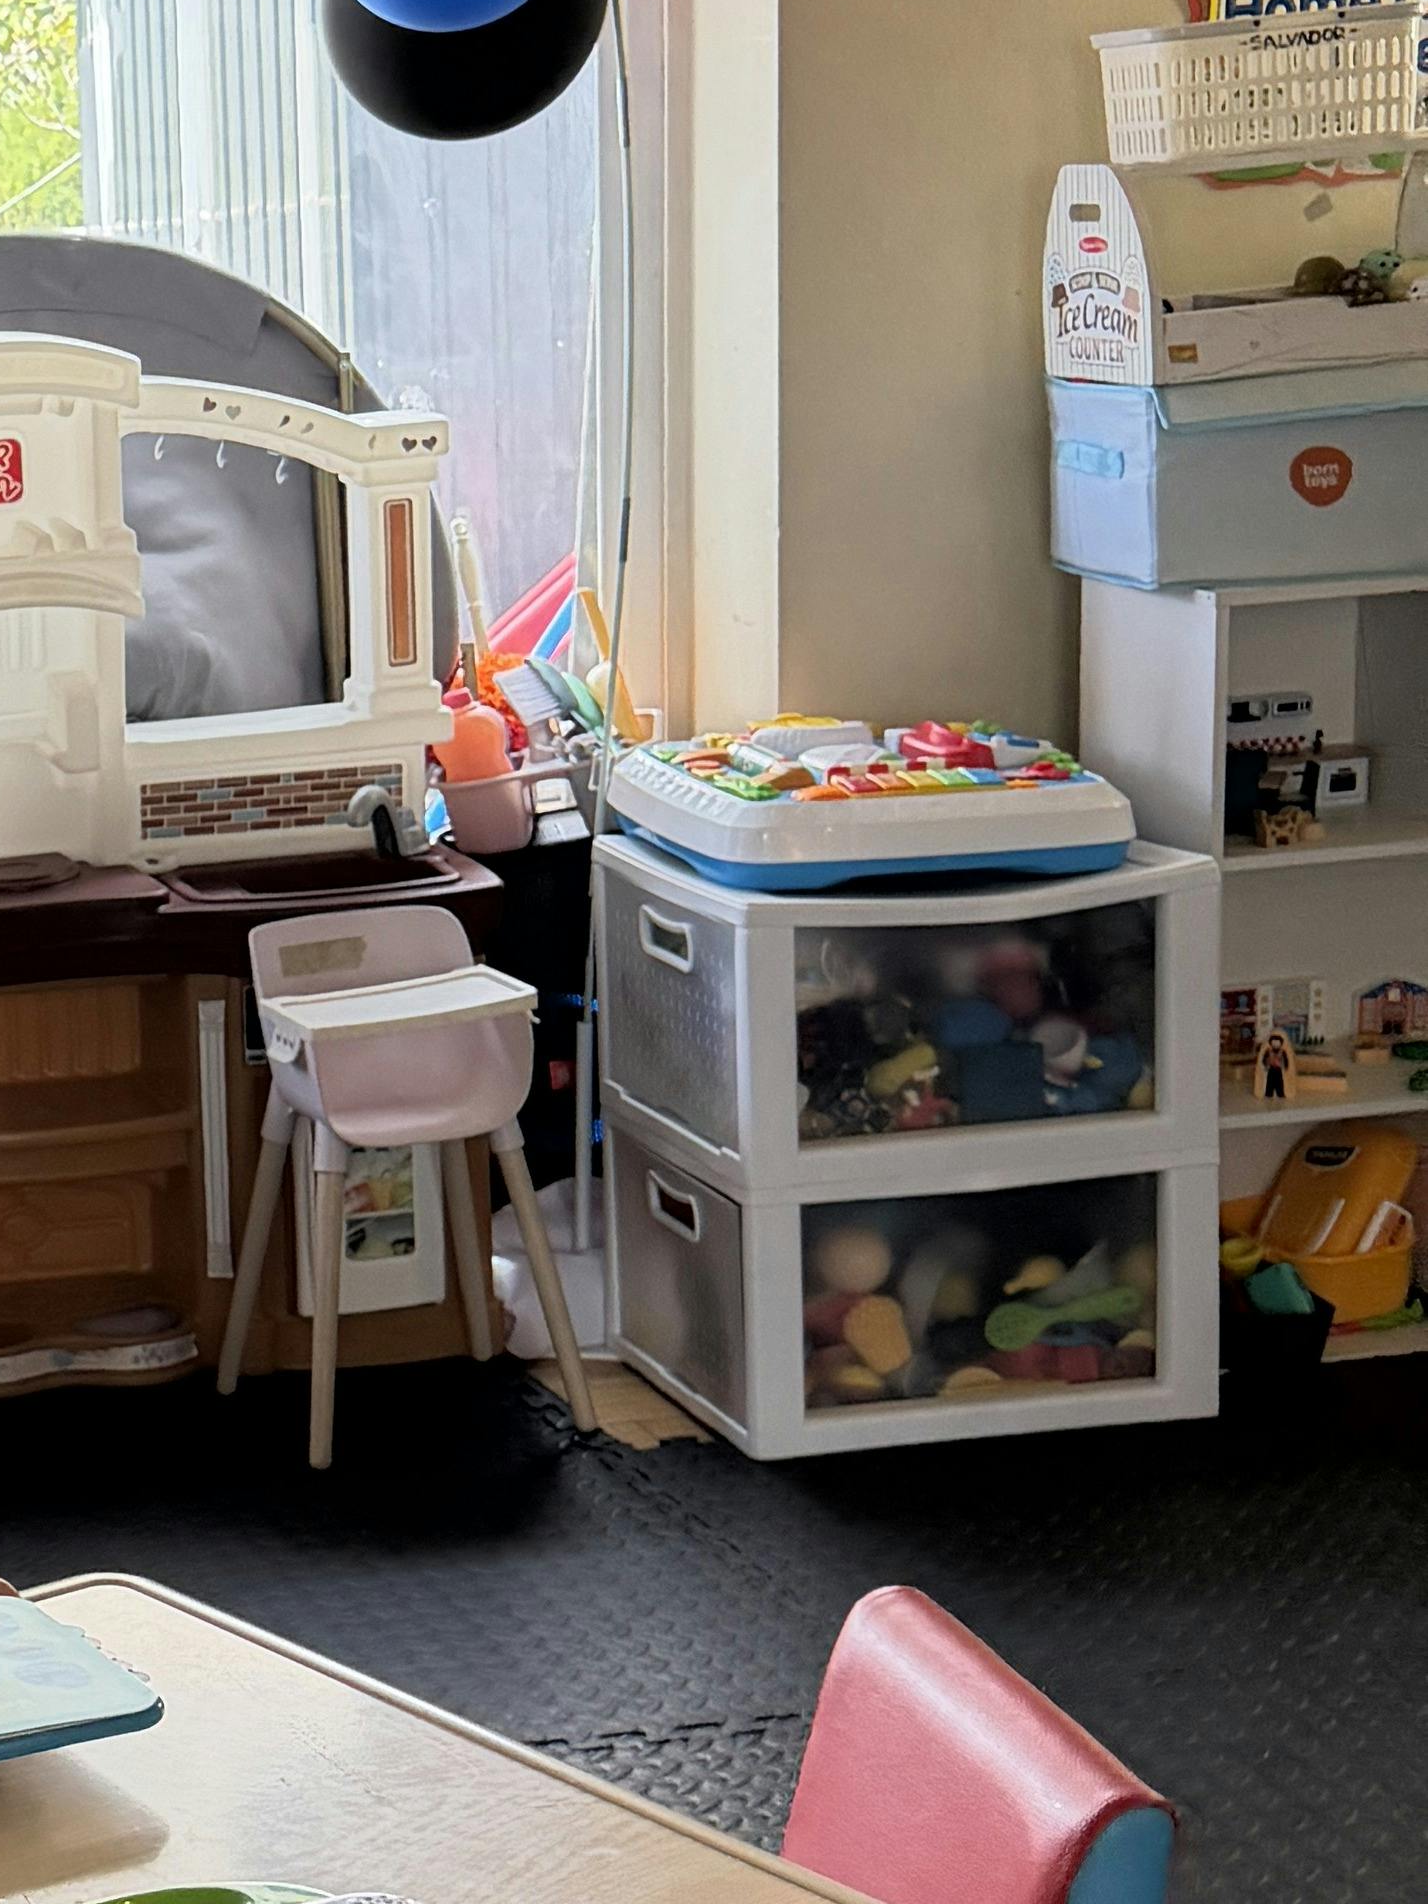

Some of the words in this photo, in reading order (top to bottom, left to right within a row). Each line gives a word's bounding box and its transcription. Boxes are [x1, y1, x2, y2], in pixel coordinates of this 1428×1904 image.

[1057, 302, 1082, 338] Ice
[1083, 293, 1138, 344] Cream
[1069, 336, 1124, 363] COUNTER
